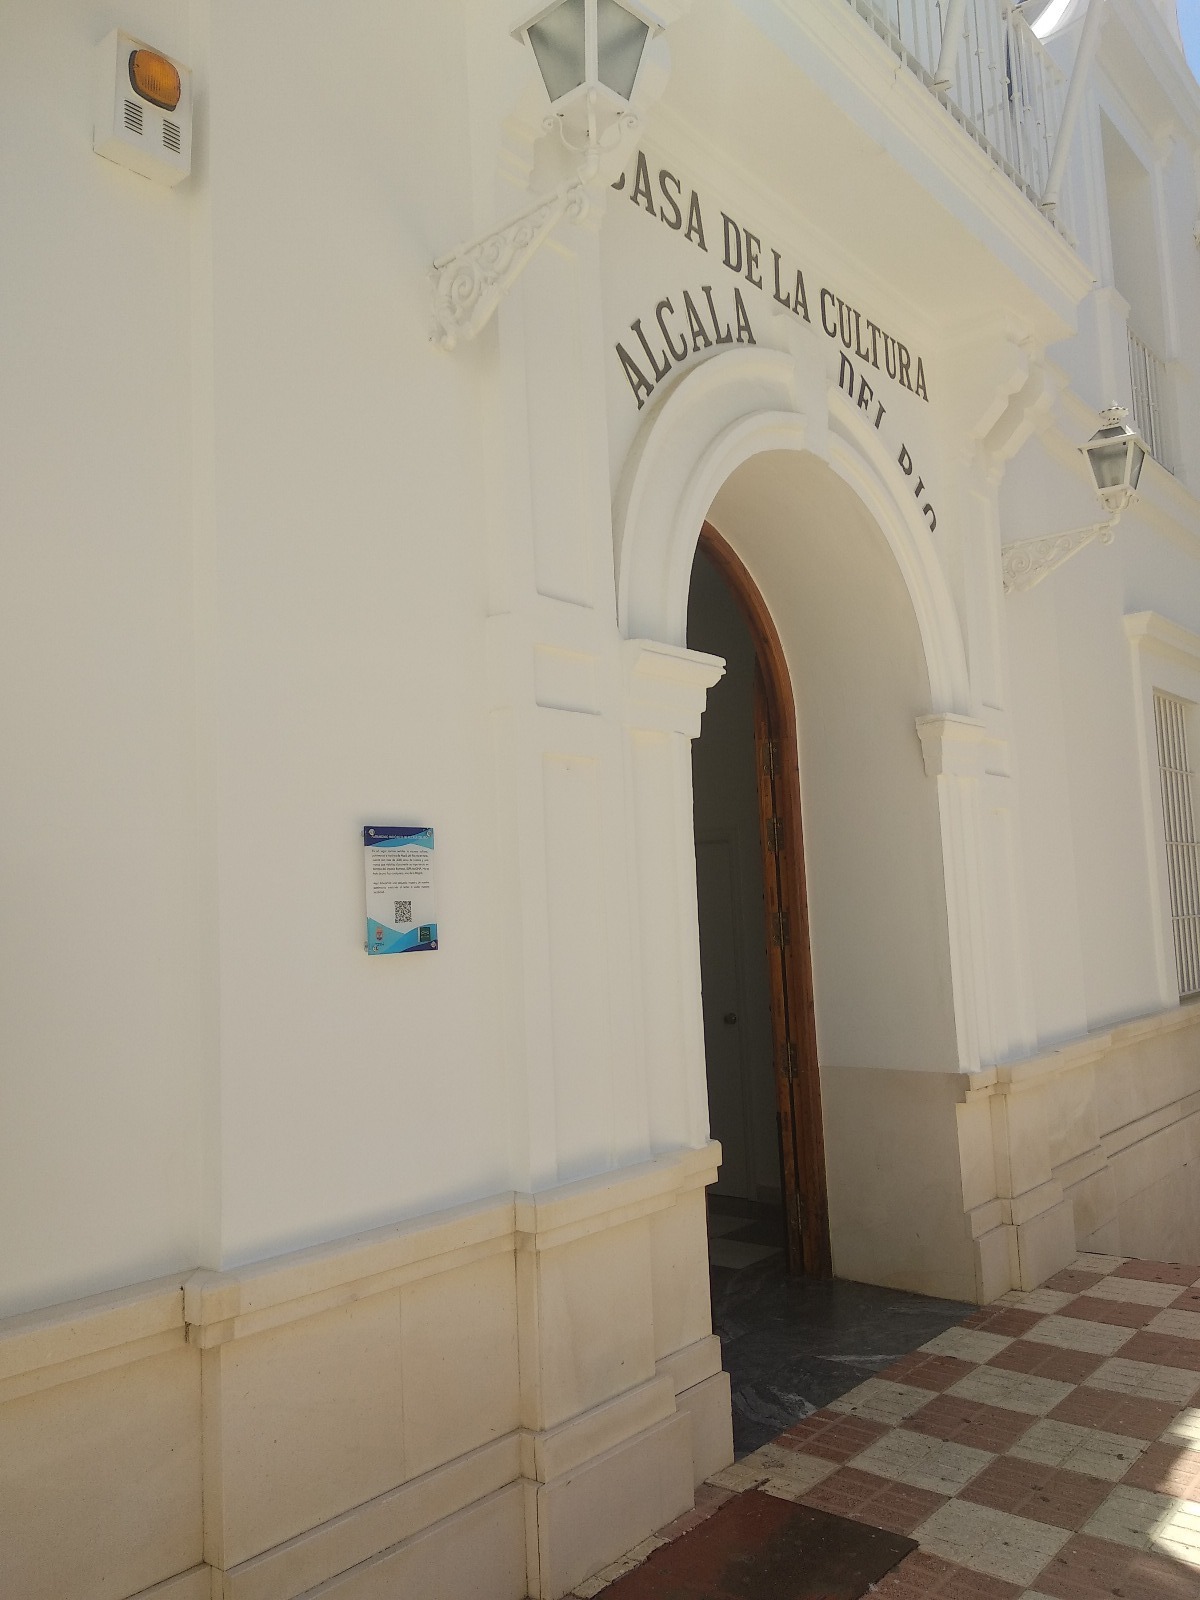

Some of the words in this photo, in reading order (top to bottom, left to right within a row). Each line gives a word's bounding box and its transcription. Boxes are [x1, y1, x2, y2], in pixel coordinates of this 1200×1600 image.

[611, 150, 709, 253] ASA
[720, 210, 763, 291] DE
[770, 247, 812, 324] LA
[819, 287, 930, 403] CULTURA
[615, 285, 757, 412] ALCALA
